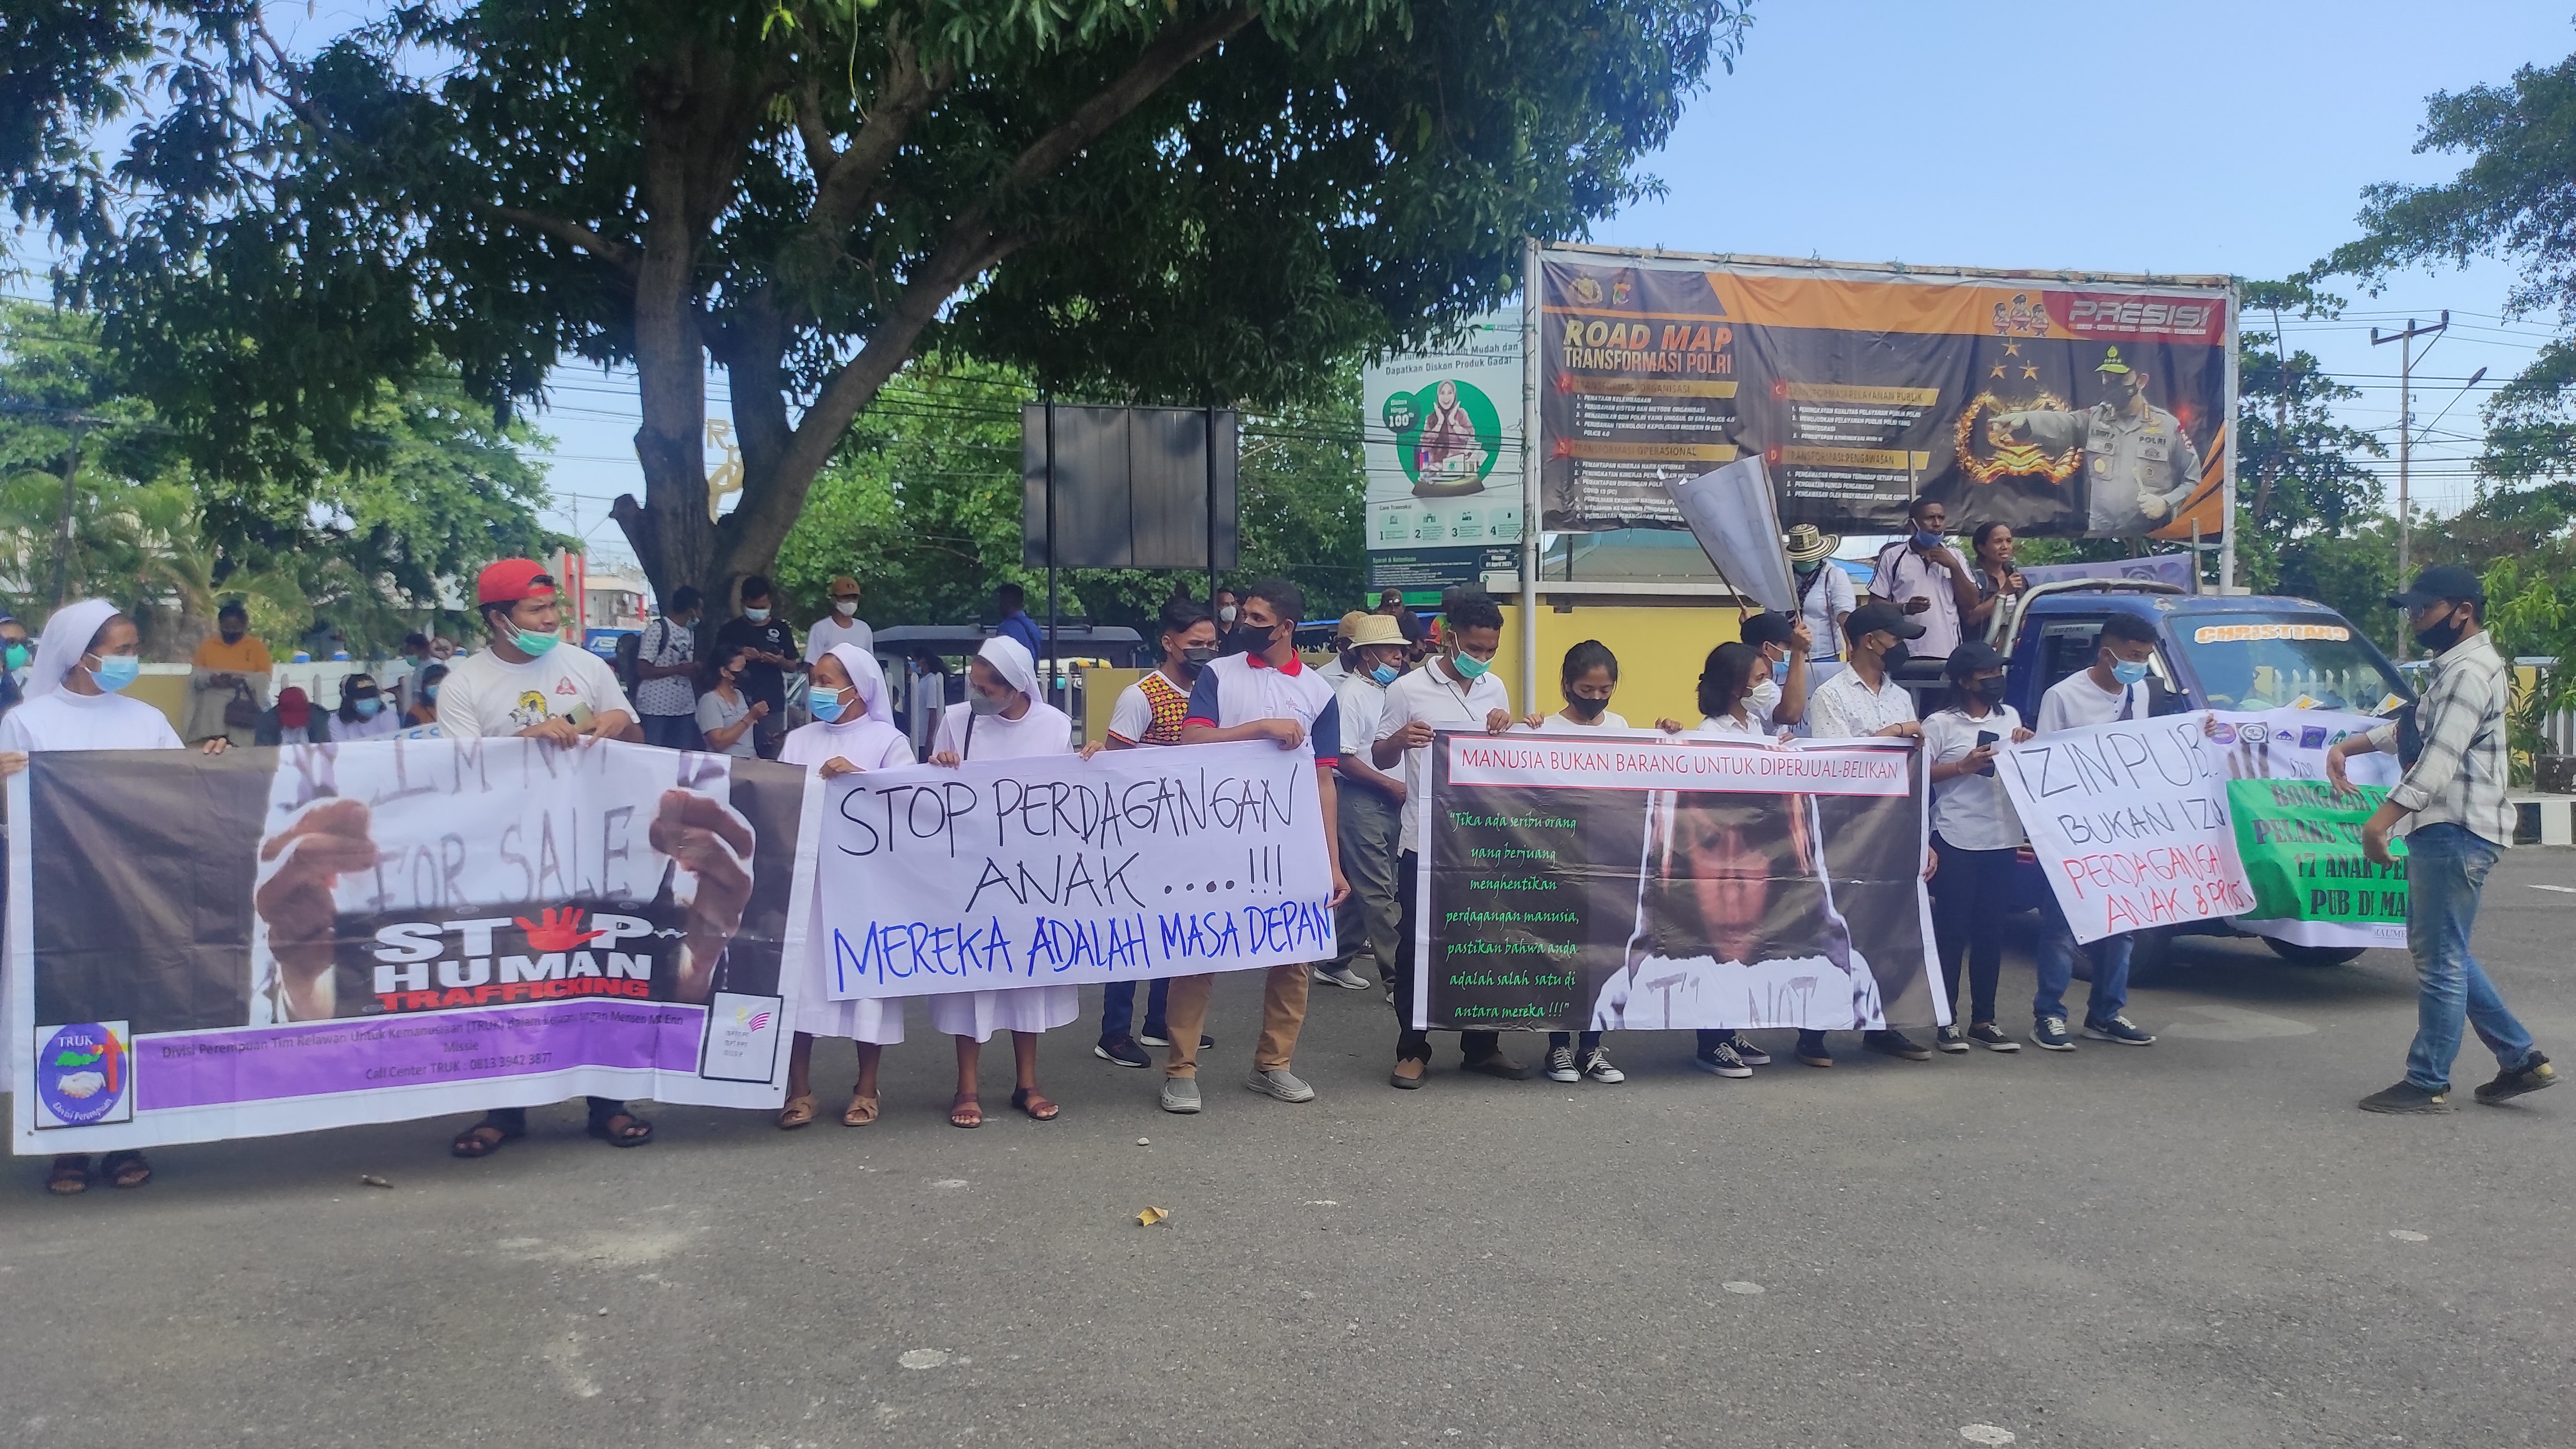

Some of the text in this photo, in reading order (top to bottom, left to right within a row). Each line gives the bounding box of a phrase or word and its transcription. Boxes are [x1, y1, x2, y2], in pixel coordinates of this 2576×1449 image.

[2069, 301, 2210, 327] PRESISI
[1563, 319, 1732, 353] ROAD MAP
[1472, 344, 1500, 354] Mudah
[1563, 346, 1732, 374] TRANSFORMASI POLRI
[1426, 362, 1452, 371] Diskon
[1456, 359, 1485, 369] Produk
[1487, 356, 1512, 366] Gadai
[1639, 383, 1691, 393] ORGANISASI
[1775, 385, 1781, 394] C
[1848, 390, 1894, 401] PELAYANAN
[1896, 392, 1924, 402] PUBLIK
[1574, 444, 1697, 456] TRANSFORMASI OPERASIONAL
[1770, 450, 1777, 460] D
[1787, 451, 1894, 465] TRANSFORMASI PENGAWASAN
[1380, 531, 1384, 540] 1
[1415, 529, 1421, 539] 2
[1452, 527, 1458, 537] 3
[1490, 526, 1497, 536] 4
[1462, 748, 1899, 779] MANUSIA BUKAN BARANG UNTUK DIPERJUAL-BELIKAN
[838, 763, 1298, 858] STOP PERDAGANGAN
[1484, 812, 1508, 830] ada
[1510, 811, 1542, 828] seribu
[1544, 817, 1577, 838] orang
[2056, 801, 2175, 846] BUKAN
[1471, 842, 1556, 868] yang berjuang
[2294, 853, 2316, 878] 17
[2325, 853, 2373, 879] ANAK
[965, 851, 1146, 913] ANAK
[2062, 843, 2221, 899] PERDAGANGA
[1470, 873, 1557, 899] menghentikan
[2107, 886, 2190, 933] ANAK
[2310, 889, 2407, 917] PUB DI MA
[1444, 907, 1579, 931] perdagangan manusia,
[833, 892, 1332, 993] MEREKA ADALAH MASA DEPAN
[1446, 937, 1577, 962] pastikan bahwa anda
[374, 951, 653, 994] HUMAN
[1449, 969, 1577, 990] adalah salah satu di
[375, 977, 649, 1011] TRAFFICKING
[1454, 1003, 1500, 1018] antara
[1501, 1001, 1546, 1019] mereka
[58, 1035, 94, 1048] TRUK
[163, 1044, 195, 1058] Divisi
[199, 1040, 268, 1055] Perempuan
[271, 1037, 293, 1049] Tim
[297, 1033, 346, 1047] Relawan
[351, 1029, 385, 1042] Untuk
[365, 1068, 386, 1080] Call
[390, 1064, 427, 1078] Center
[430, 1061, 460, 1074] TRUK
